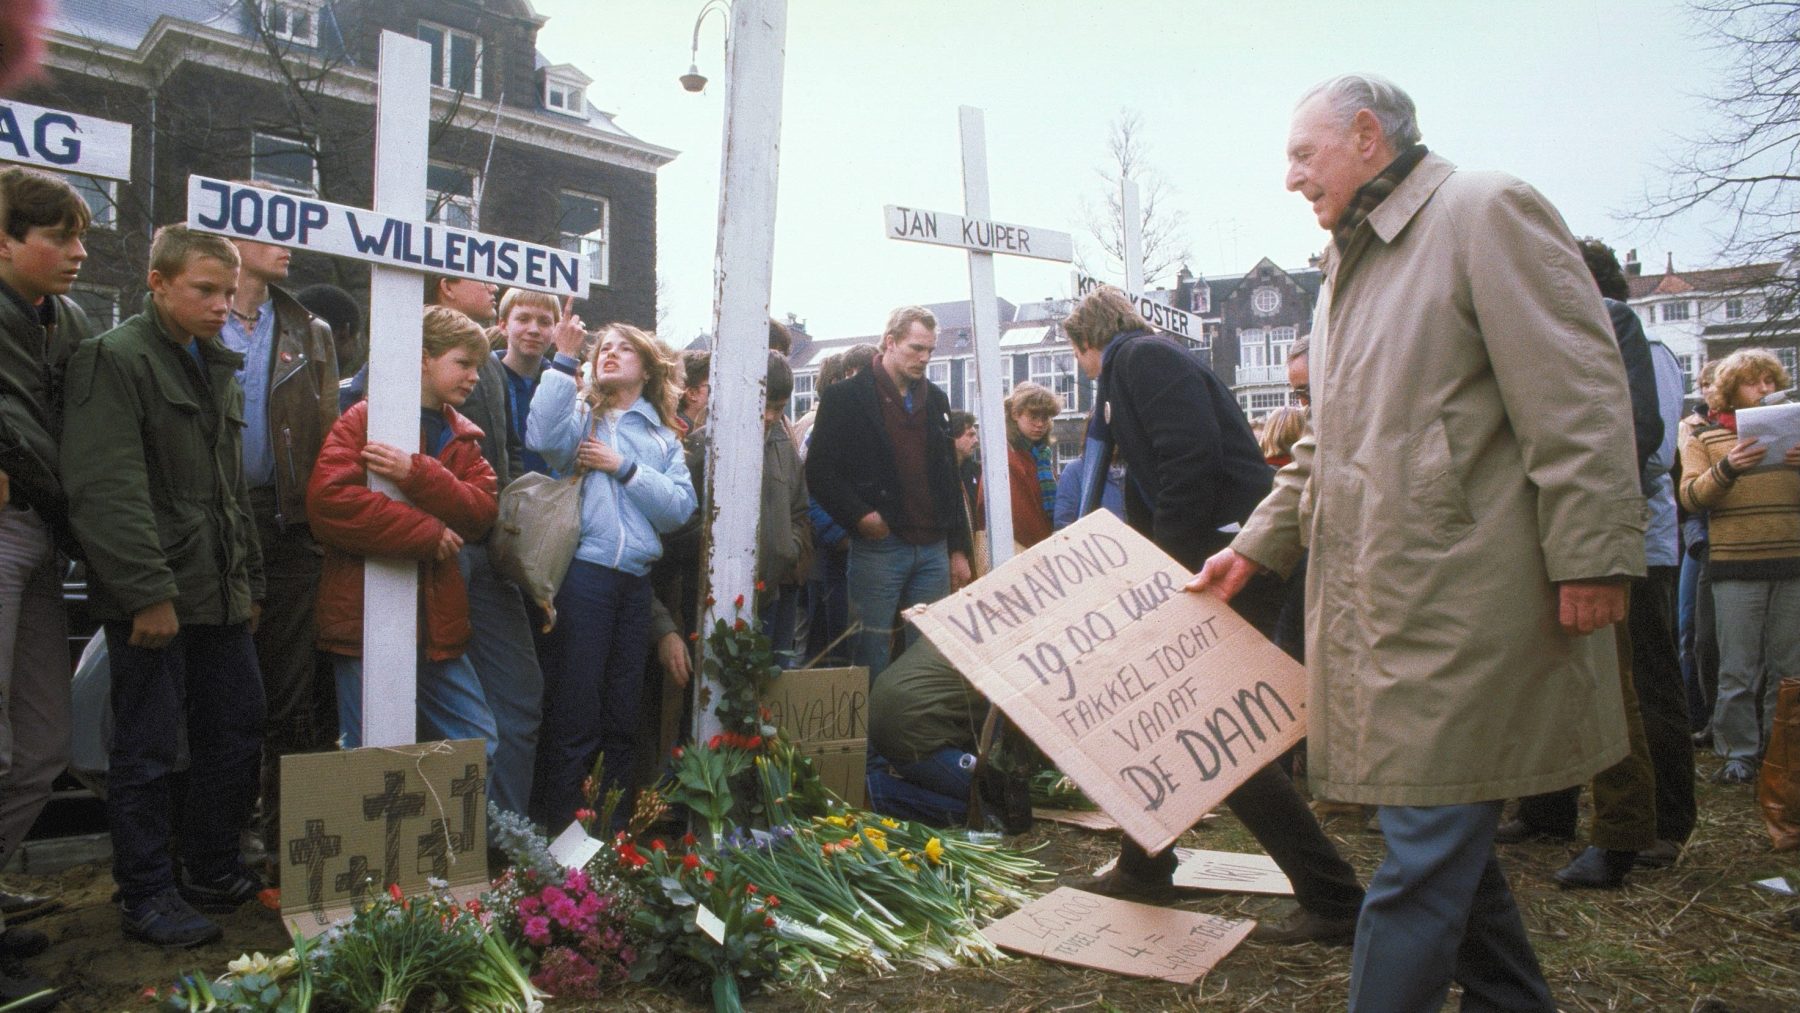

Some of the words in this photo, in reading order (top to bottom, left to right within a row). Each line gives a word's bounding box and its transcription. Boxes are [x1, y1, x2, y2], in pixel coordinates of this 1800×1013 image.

[199, 180, 329, 245] JOOP
[346, 211, 579, 293] WILLEMSEN
[895, 206, 938, 239] JAN
[962, 217, 1031, 253] KUIPER
[948, 532, 1129, 645] VANAVOND
[1017, 611, 1117, 701] 19.00
[1112, 676, 1198, 753] VANAF
[1119, 754, 1182, 812] DE
[1176, 680, 1297, 782] DAM
